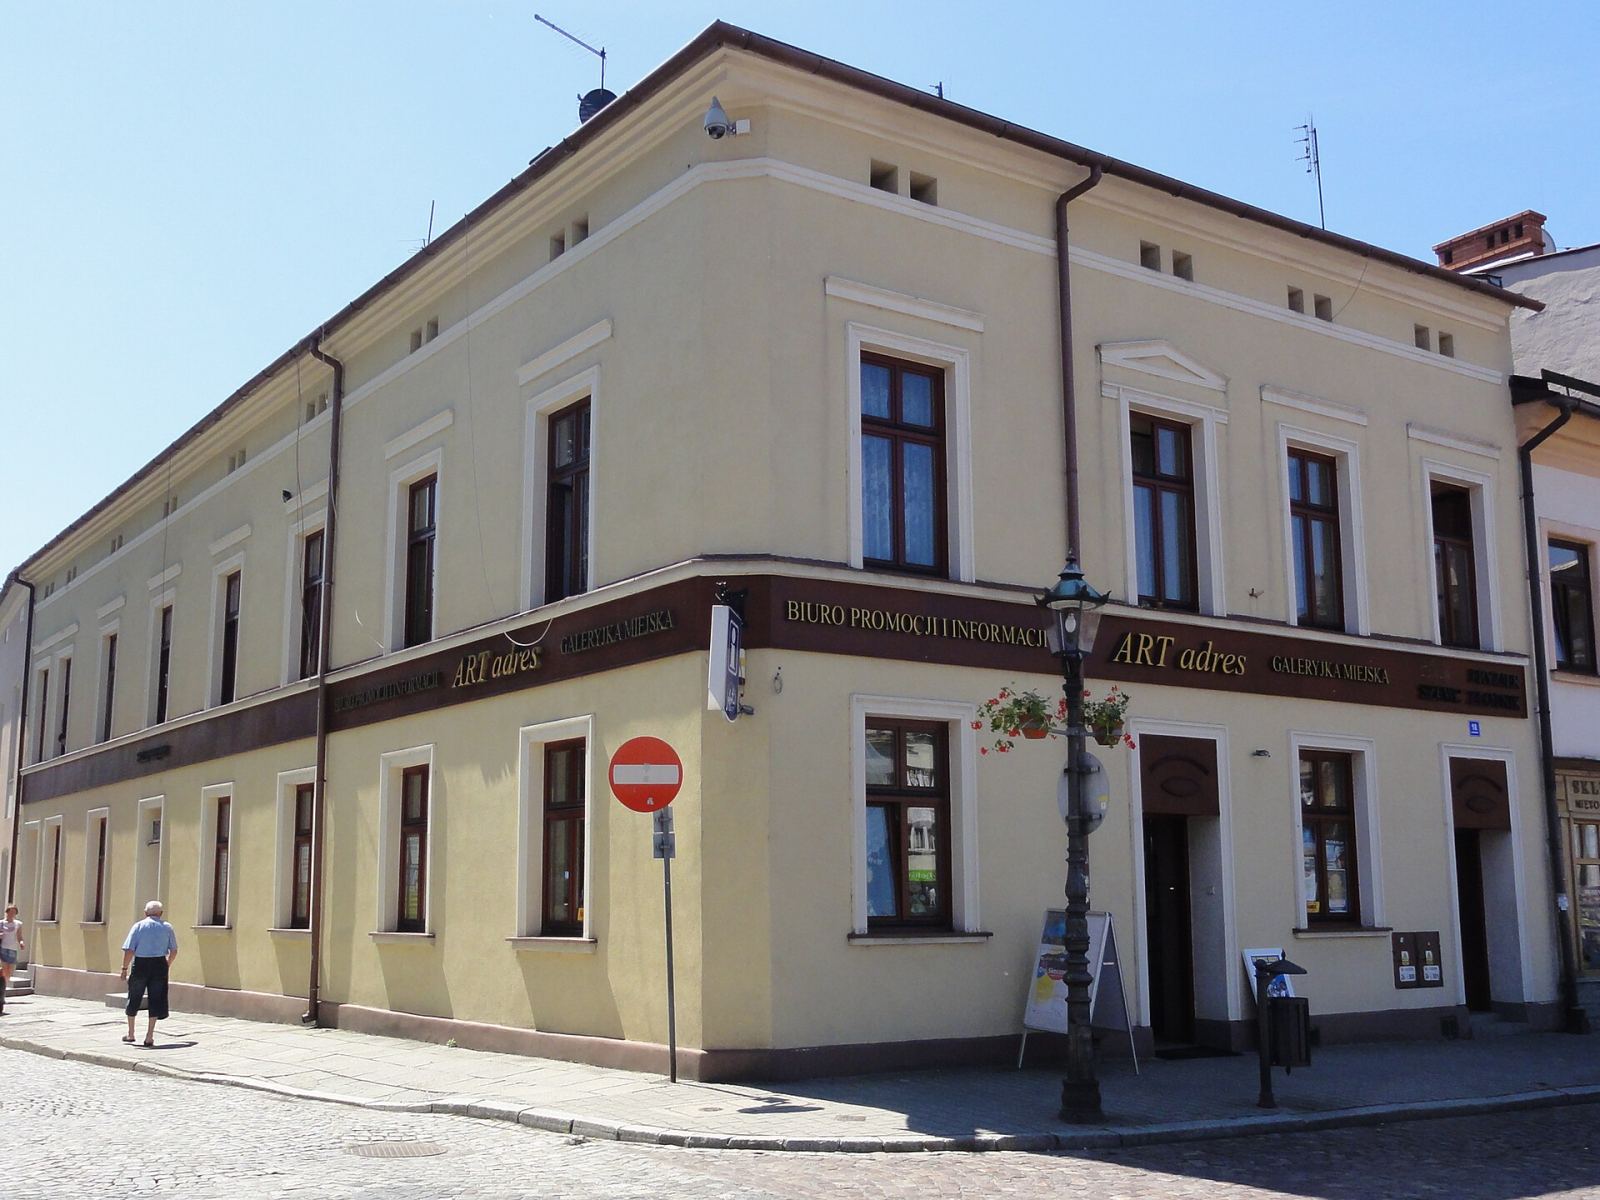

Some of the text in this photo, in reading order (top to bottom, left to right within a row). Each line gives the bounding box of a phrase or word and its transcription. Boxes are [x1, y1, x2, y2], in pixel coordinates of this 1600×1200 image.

[561, 608, 674, 656] GALERYJKA MIEJSKA
[787, 600, 1048, 648] BIURO PROMOCJI I INFORMACJI
[452, 643, 541, 689] ART adres
[1113, 632, 1247, 676] ART adres
[1272, 655, 1391, 685] GALERYJKA MIEJSKA
